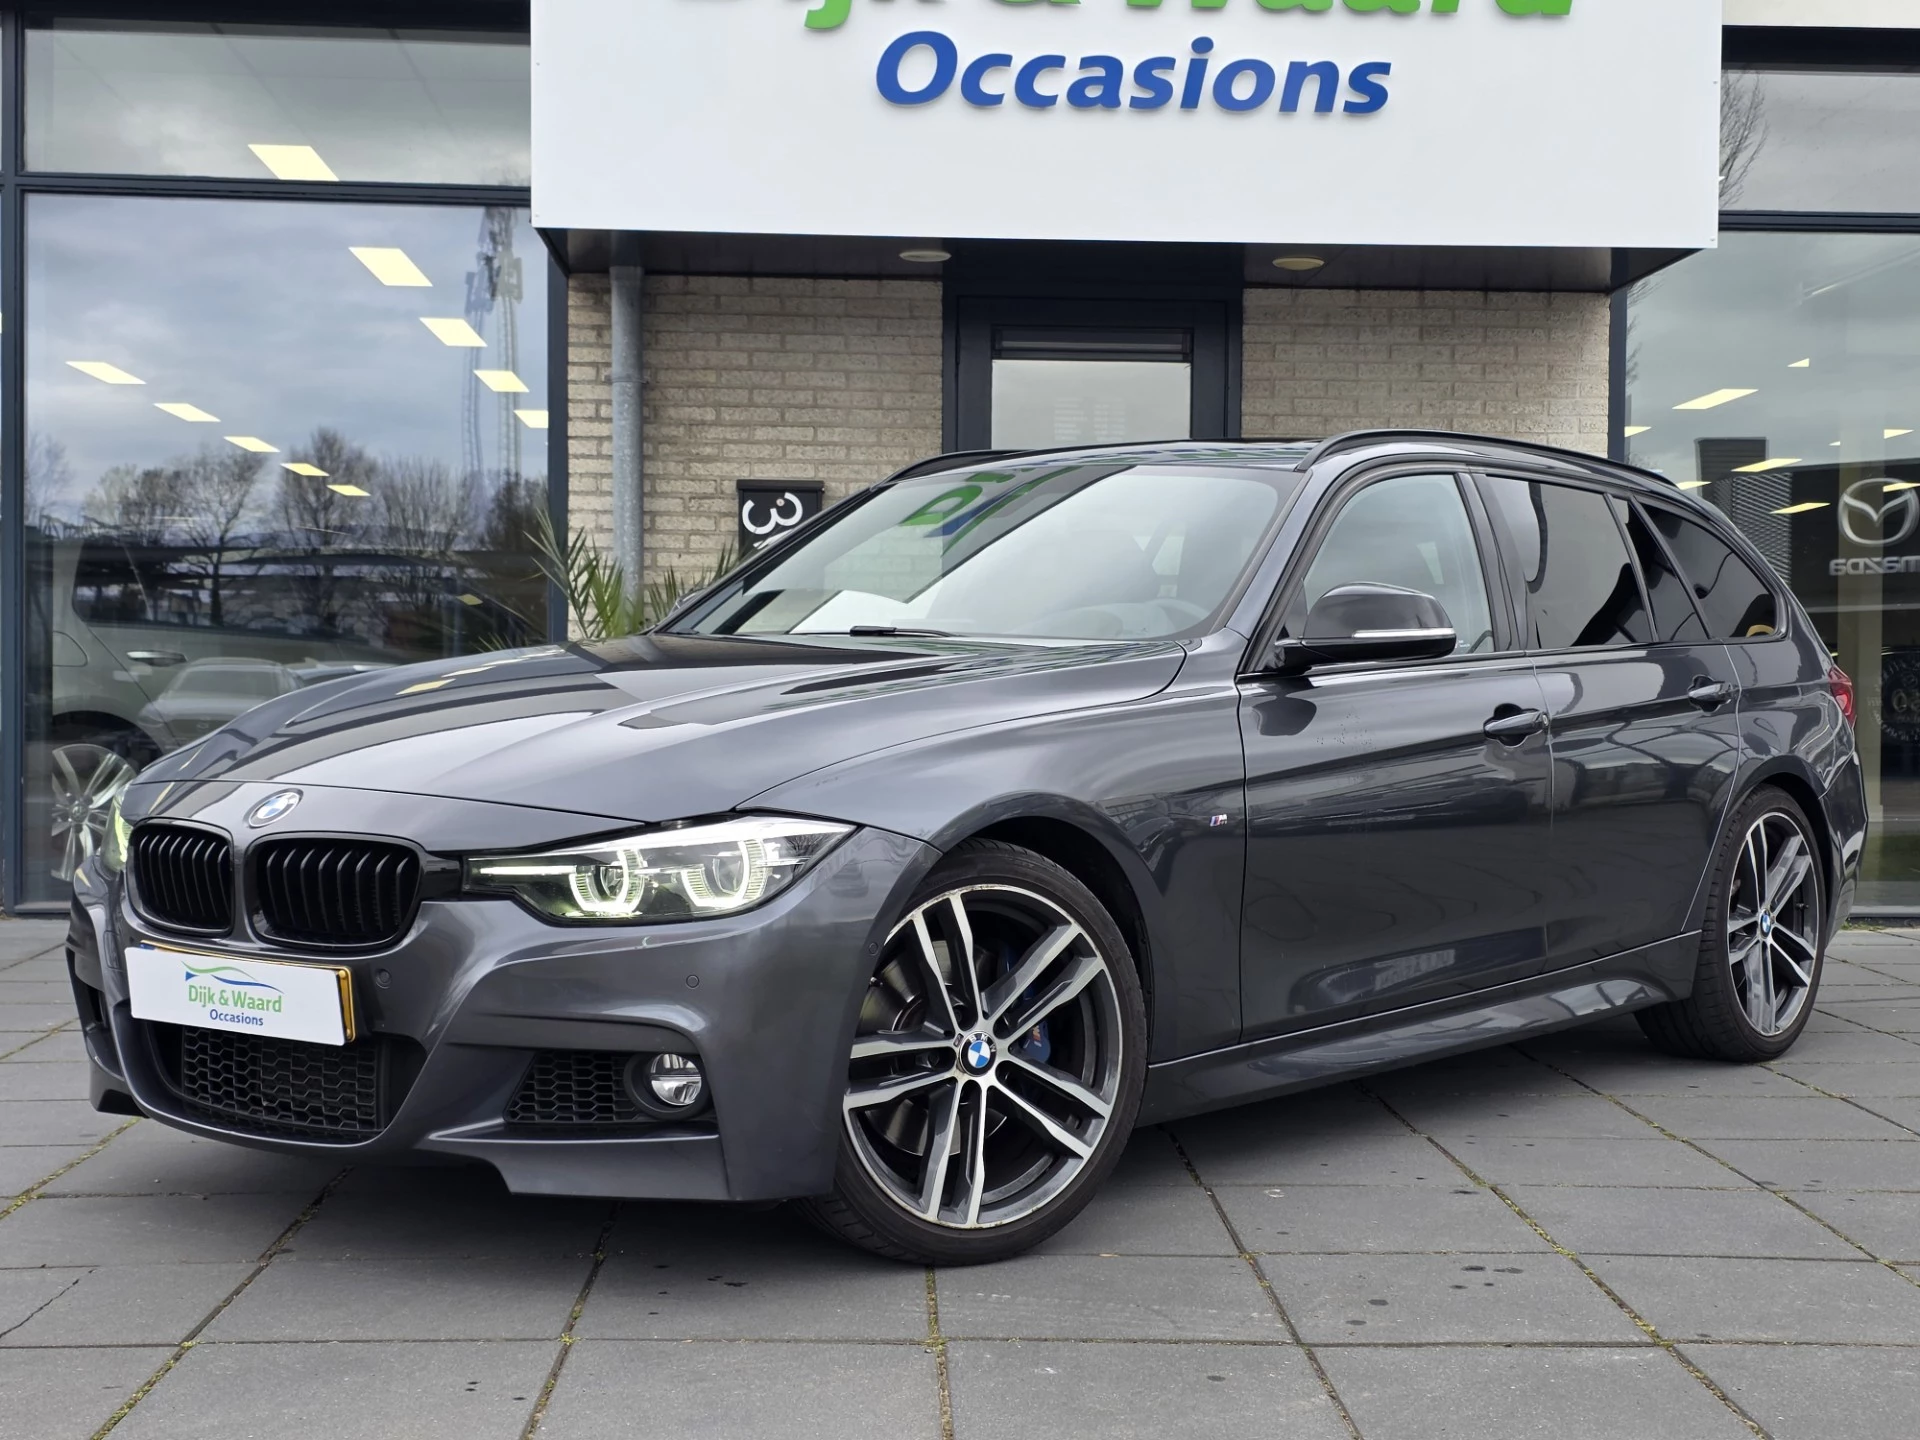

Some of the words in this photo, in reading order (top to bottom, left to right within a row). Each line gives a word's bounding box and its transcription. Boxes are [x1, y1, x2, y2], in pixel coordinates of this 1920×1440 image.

[876, 31, 1392, 114] Occasions
[742, 492, 803, 550] 3
[188, 984, 216, 1008] Dijk
[218, 989, 230, 1006] &
[231, 990, 282, 1013] Waard
[209, 1008, 264, 1026] Occasions
